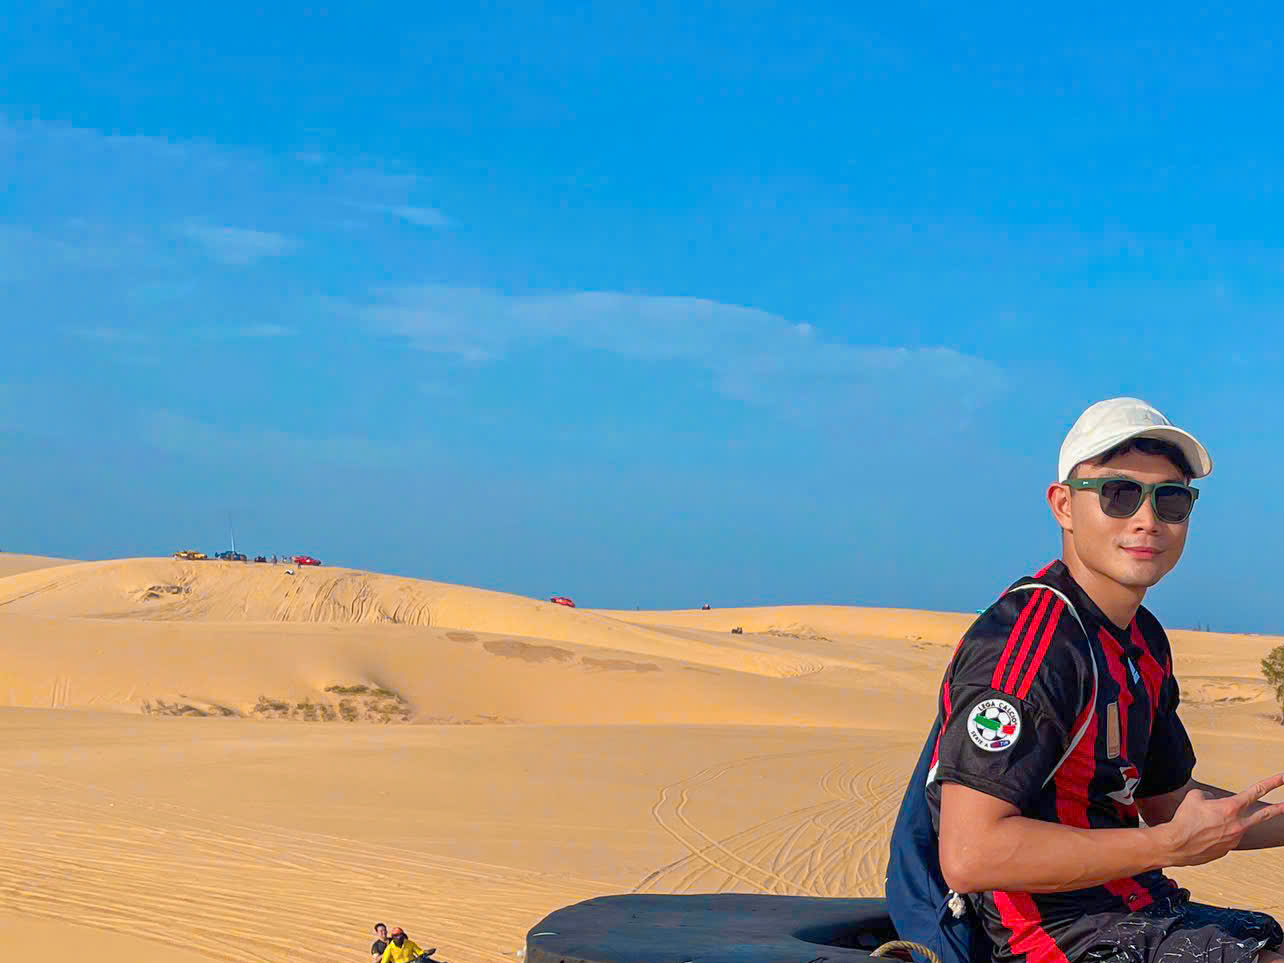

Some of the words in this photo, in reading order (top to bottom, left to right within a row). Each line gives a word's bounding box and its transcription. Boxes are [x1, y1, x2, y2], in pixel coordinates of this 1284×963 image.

[978, 701, 995, 711] LEGA
[999, 703, 1017, 723] CALCIO
[970, 731, 983, 745] SERIE
